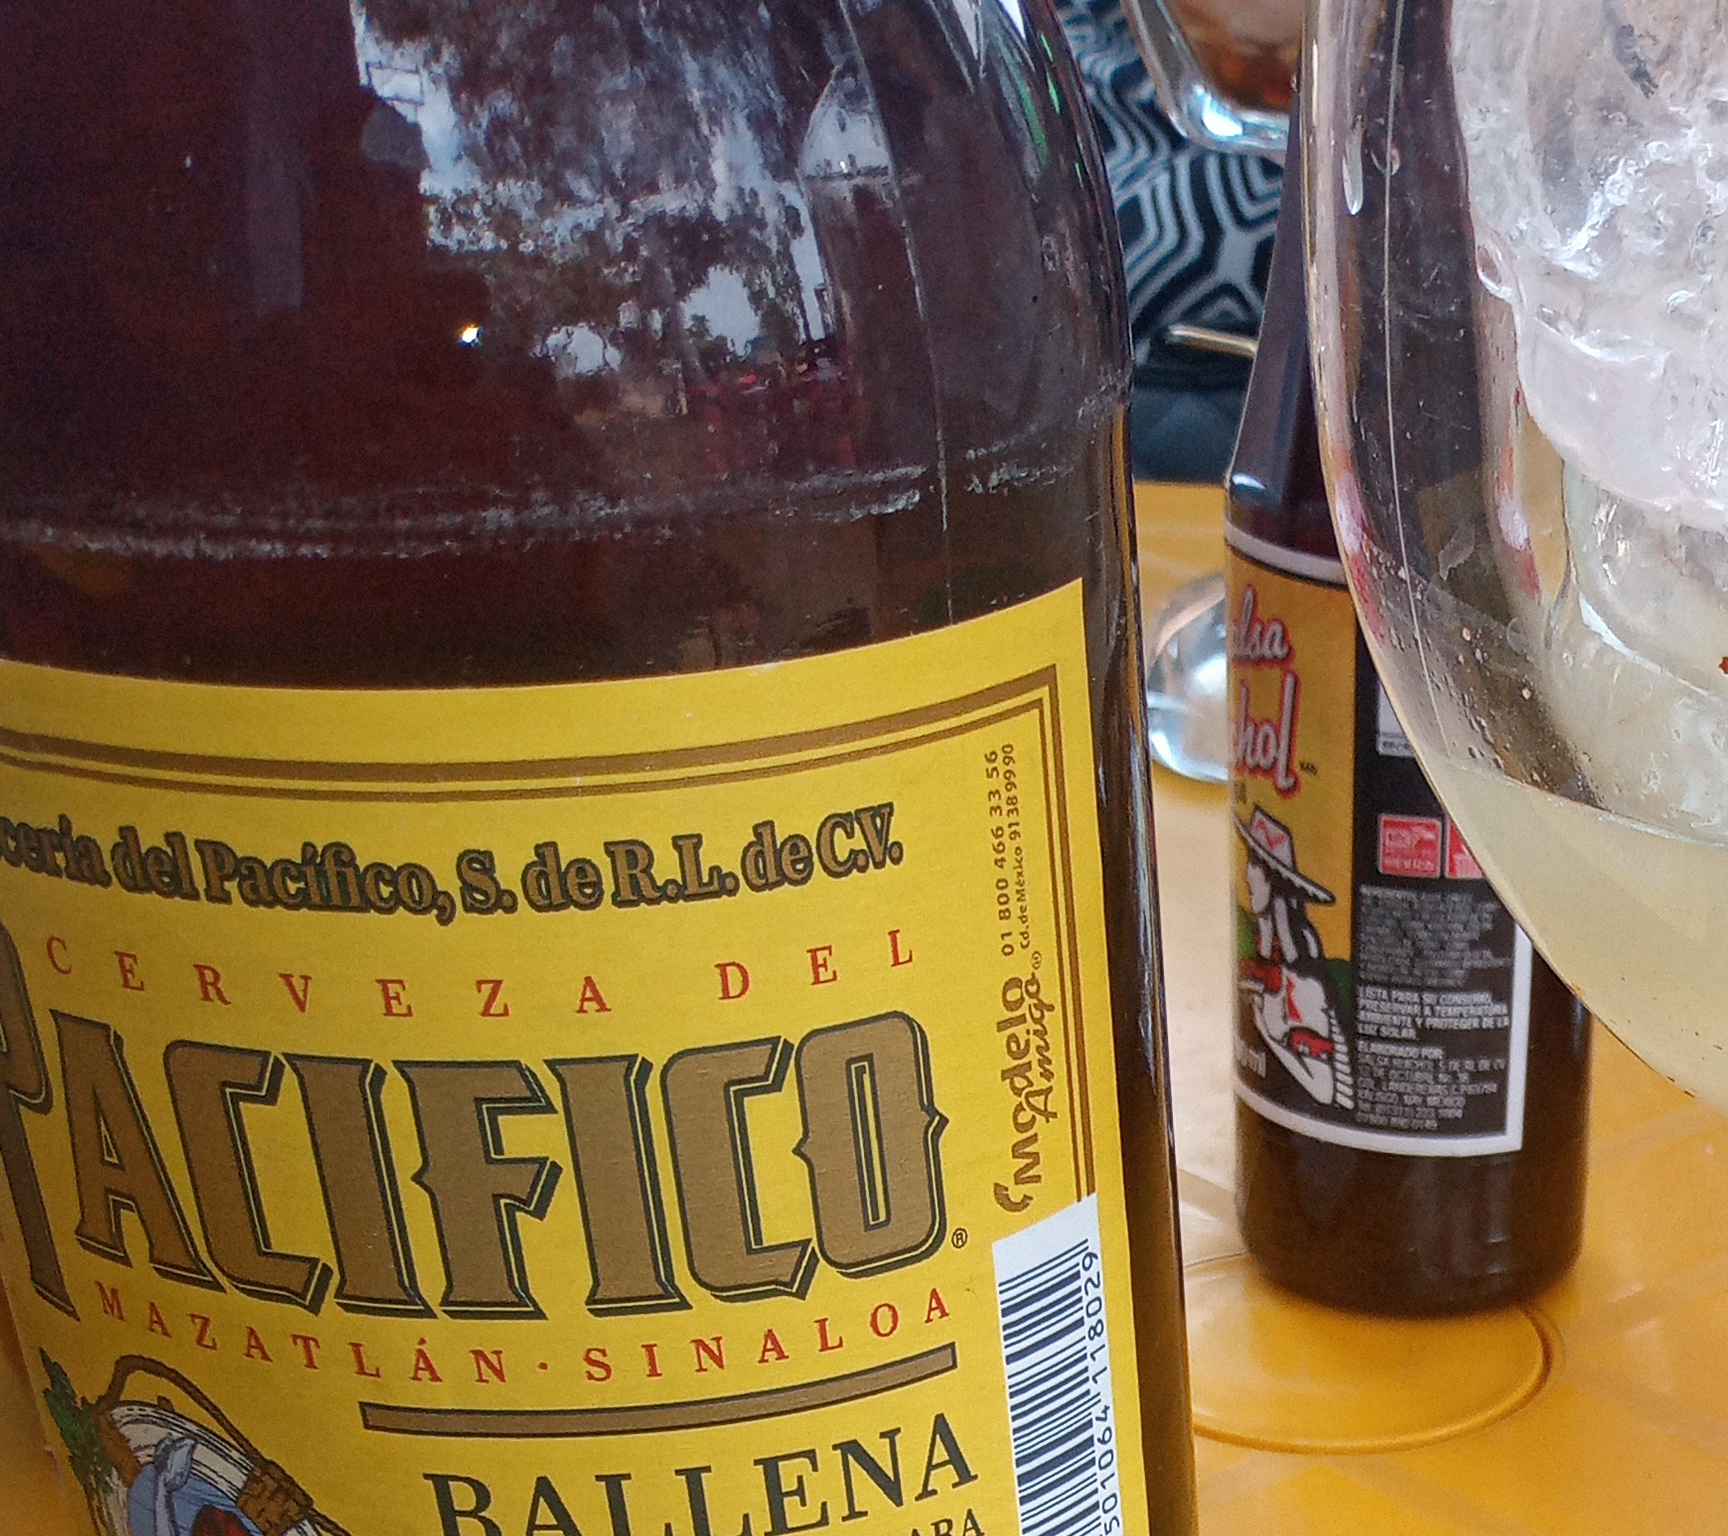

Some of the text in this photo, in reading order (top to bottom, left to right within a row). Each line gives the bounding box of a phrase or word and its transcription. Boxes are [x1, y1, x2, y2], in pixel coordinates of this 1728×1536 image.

[110, 825, 200, 900] del
[194, 839, 457, 926] Pacífico,
[456, 848, 518, 914] S.
[520, 841, 604, 913] de
[604, 832, 740, 908] R.L.
[740, 819, 815, 892] de
[984, 750, 1015, 957] 01 800 466 33 56
[46, 928, 914, 1018] CERVEZA DEL
[996, 975, 1042, 1187] Modelo
[1022, 970, 1058, 1123] Amigo
[96, 1281, 950, 1384] MAZATLÁN SINALOA
